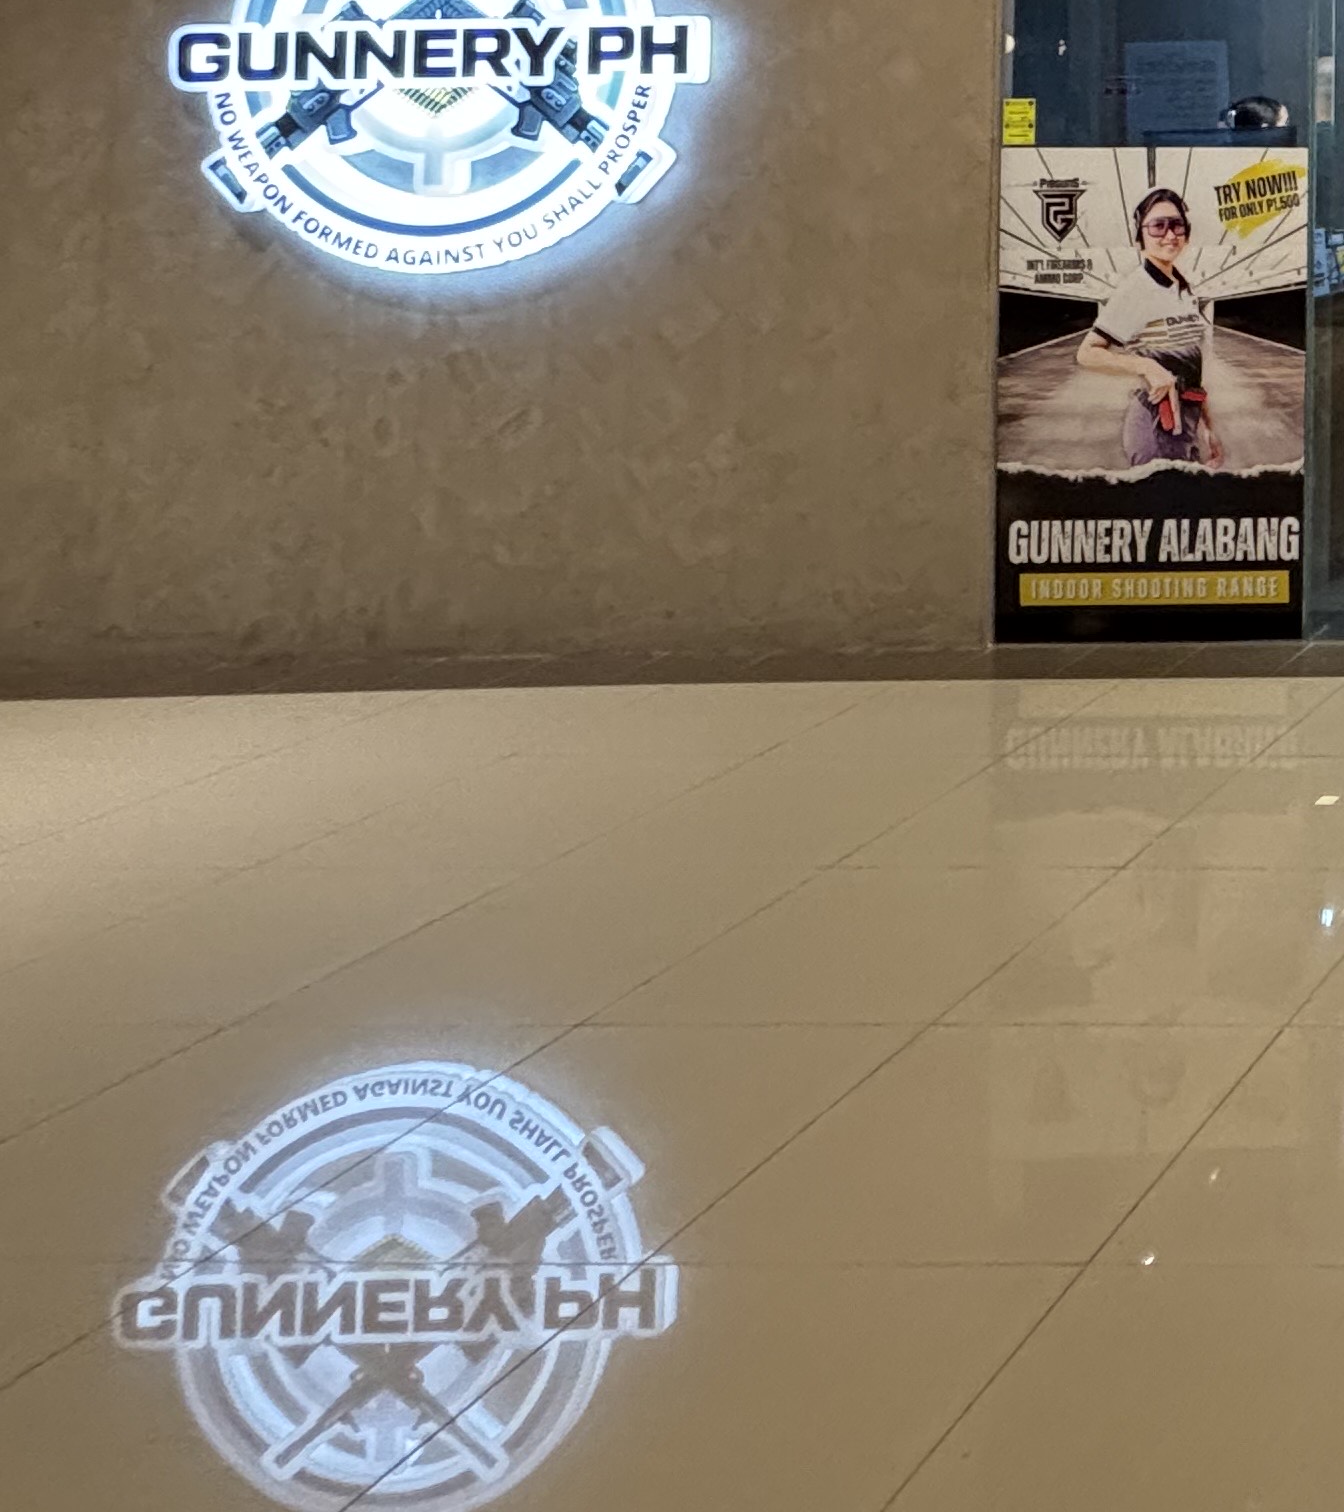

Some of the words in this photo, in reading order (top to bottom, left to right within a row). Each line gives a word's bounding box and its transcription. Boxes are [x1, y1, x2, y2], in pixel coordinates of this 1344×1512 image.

[178, 27, 565, 83] GUNNERY
[588, 25, 689, 76] PH
[215, 92, 237, 126] NO
[227, 129, 294, 214] WEAPON
[292, 210, 378, 259] FORMED
[385, 243, 484, 266] AGAINST
[492, 224, 538, 253] YOU
[542, 179, 602, 230] SHALL
[598, 84, 652, 176] PROSPER
[1213, 181, 1241, 206] TRY
[1245, 170, 1299, 200] NOW!!!
[1219, 206, 1238, 222] FOR
[1239, 200, 1264, 217] ONLY
[1008, 519, 1154, 565] GUNNERY
[1158, 517, 1300, 562] ALABANG
[1031, 578, 1101, 600] INDOOR
[1111, 577, 1208, 600] SHOOTING
[1216, 576, 1279, 598] RANGE
